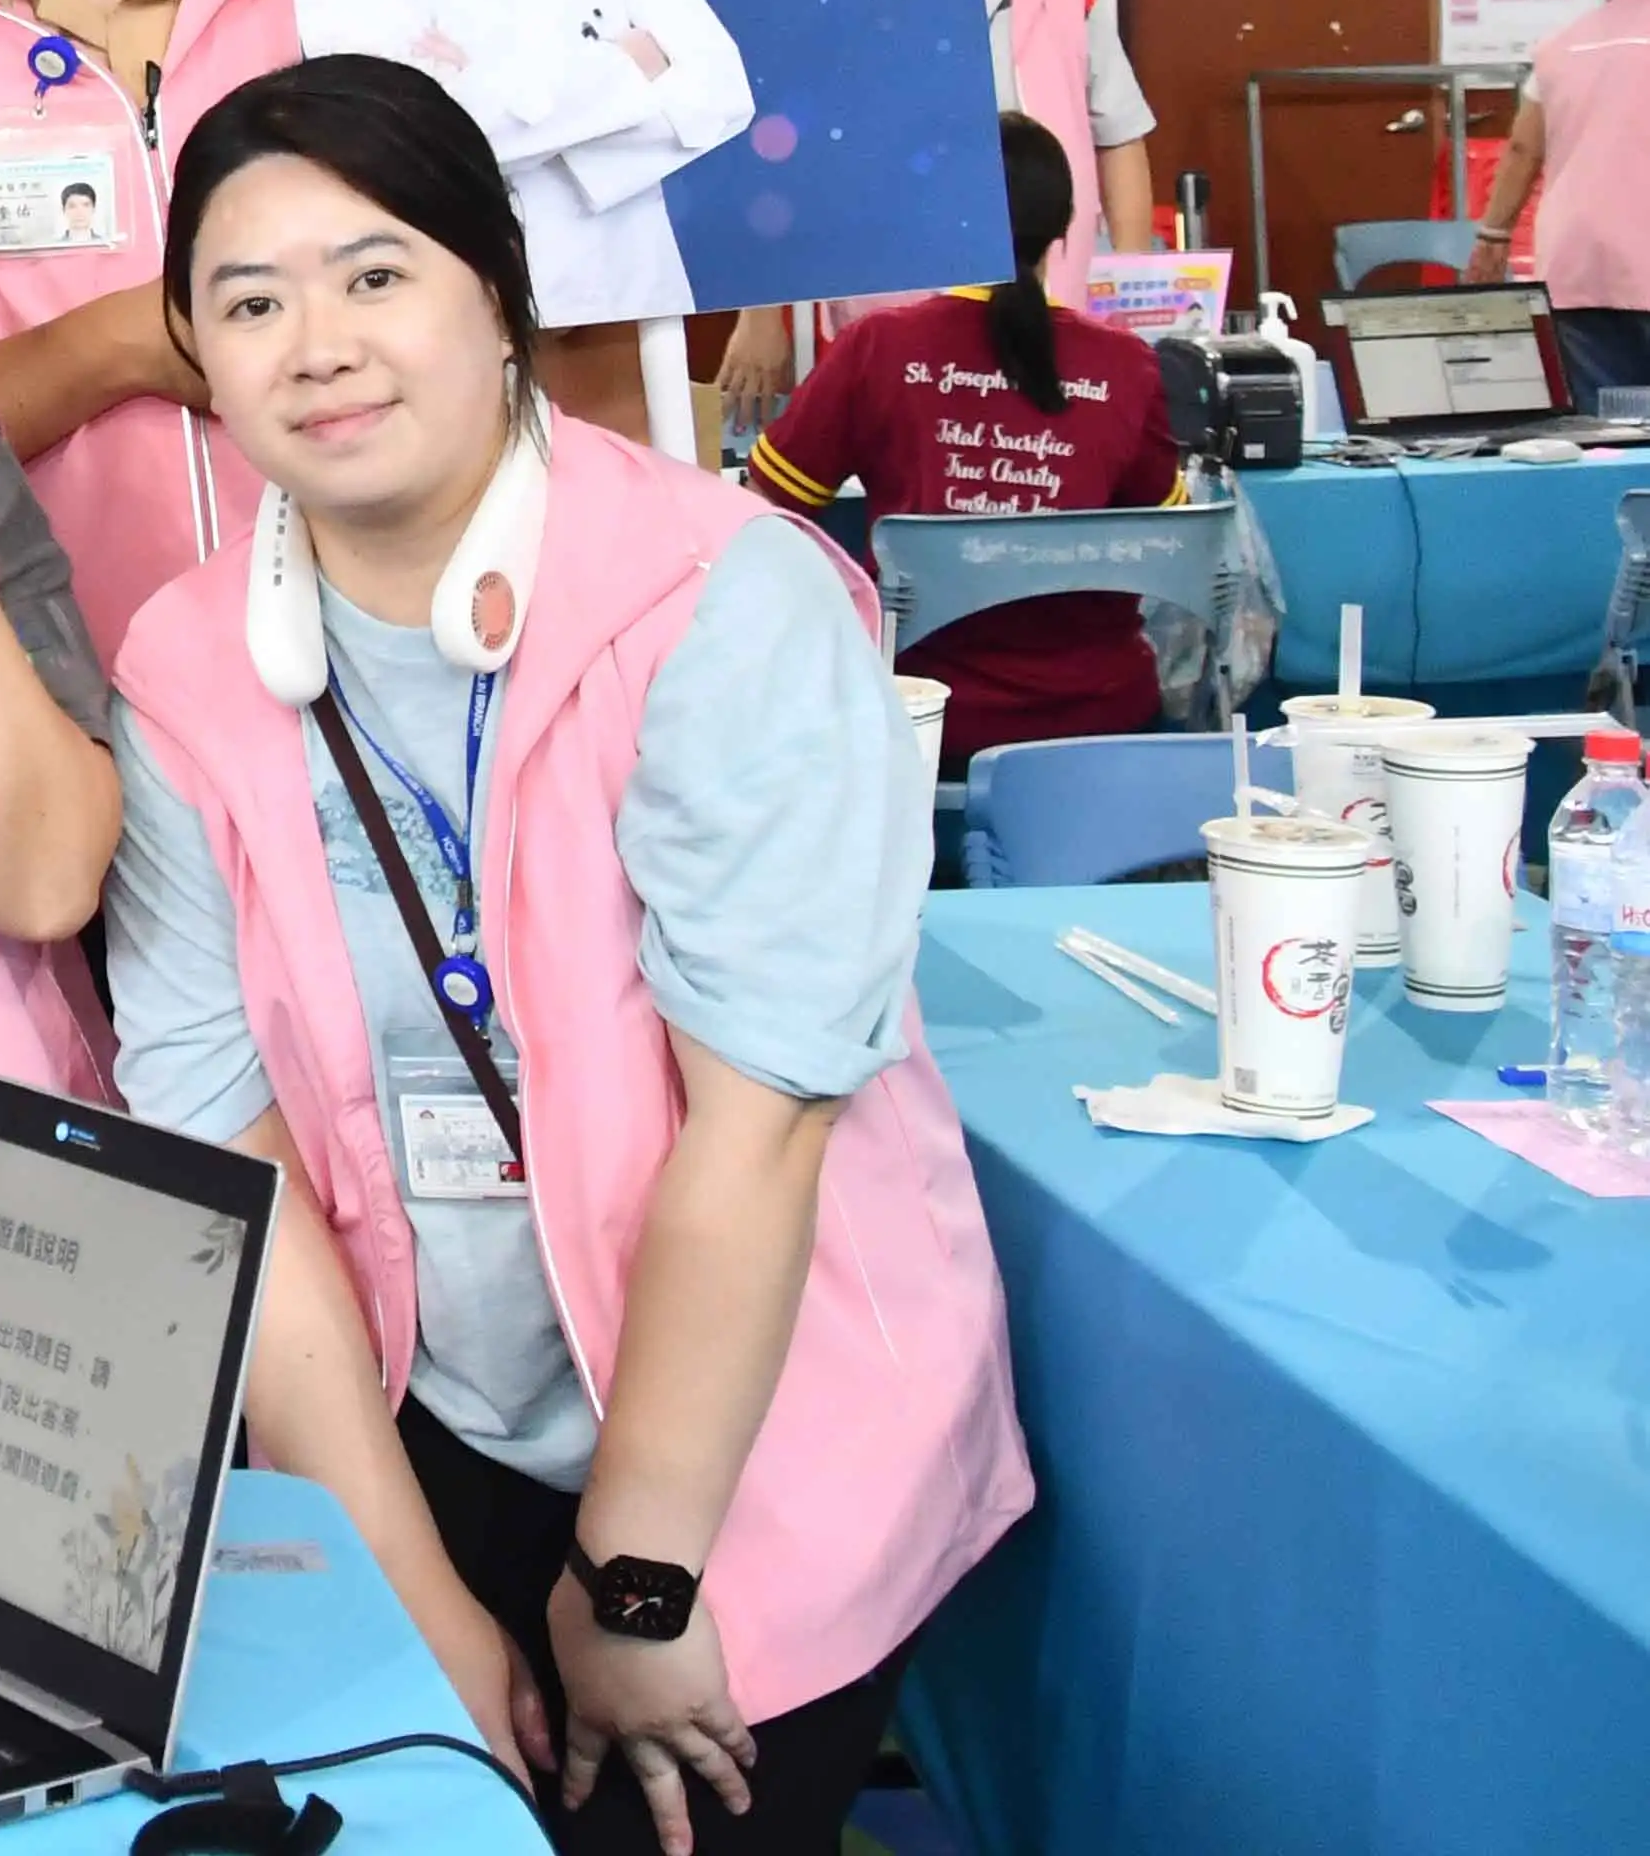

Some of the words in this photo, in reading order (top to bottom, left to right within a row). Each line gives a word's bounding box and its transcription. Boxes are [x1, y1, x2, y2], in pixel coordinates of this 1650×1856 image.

[905, 362, 933, 385] St.
[939, 363, 1008, 397] Joseph
[936, 419, 985, 447] Total
[989, 423, 1075, 461] Sacrifice
[945, 453, 985, 481] True
[990, 457, 1061, 498] Charity
[945, 486, 1019, 514] Constant
[471, 694, 486, 736] BRANCH
